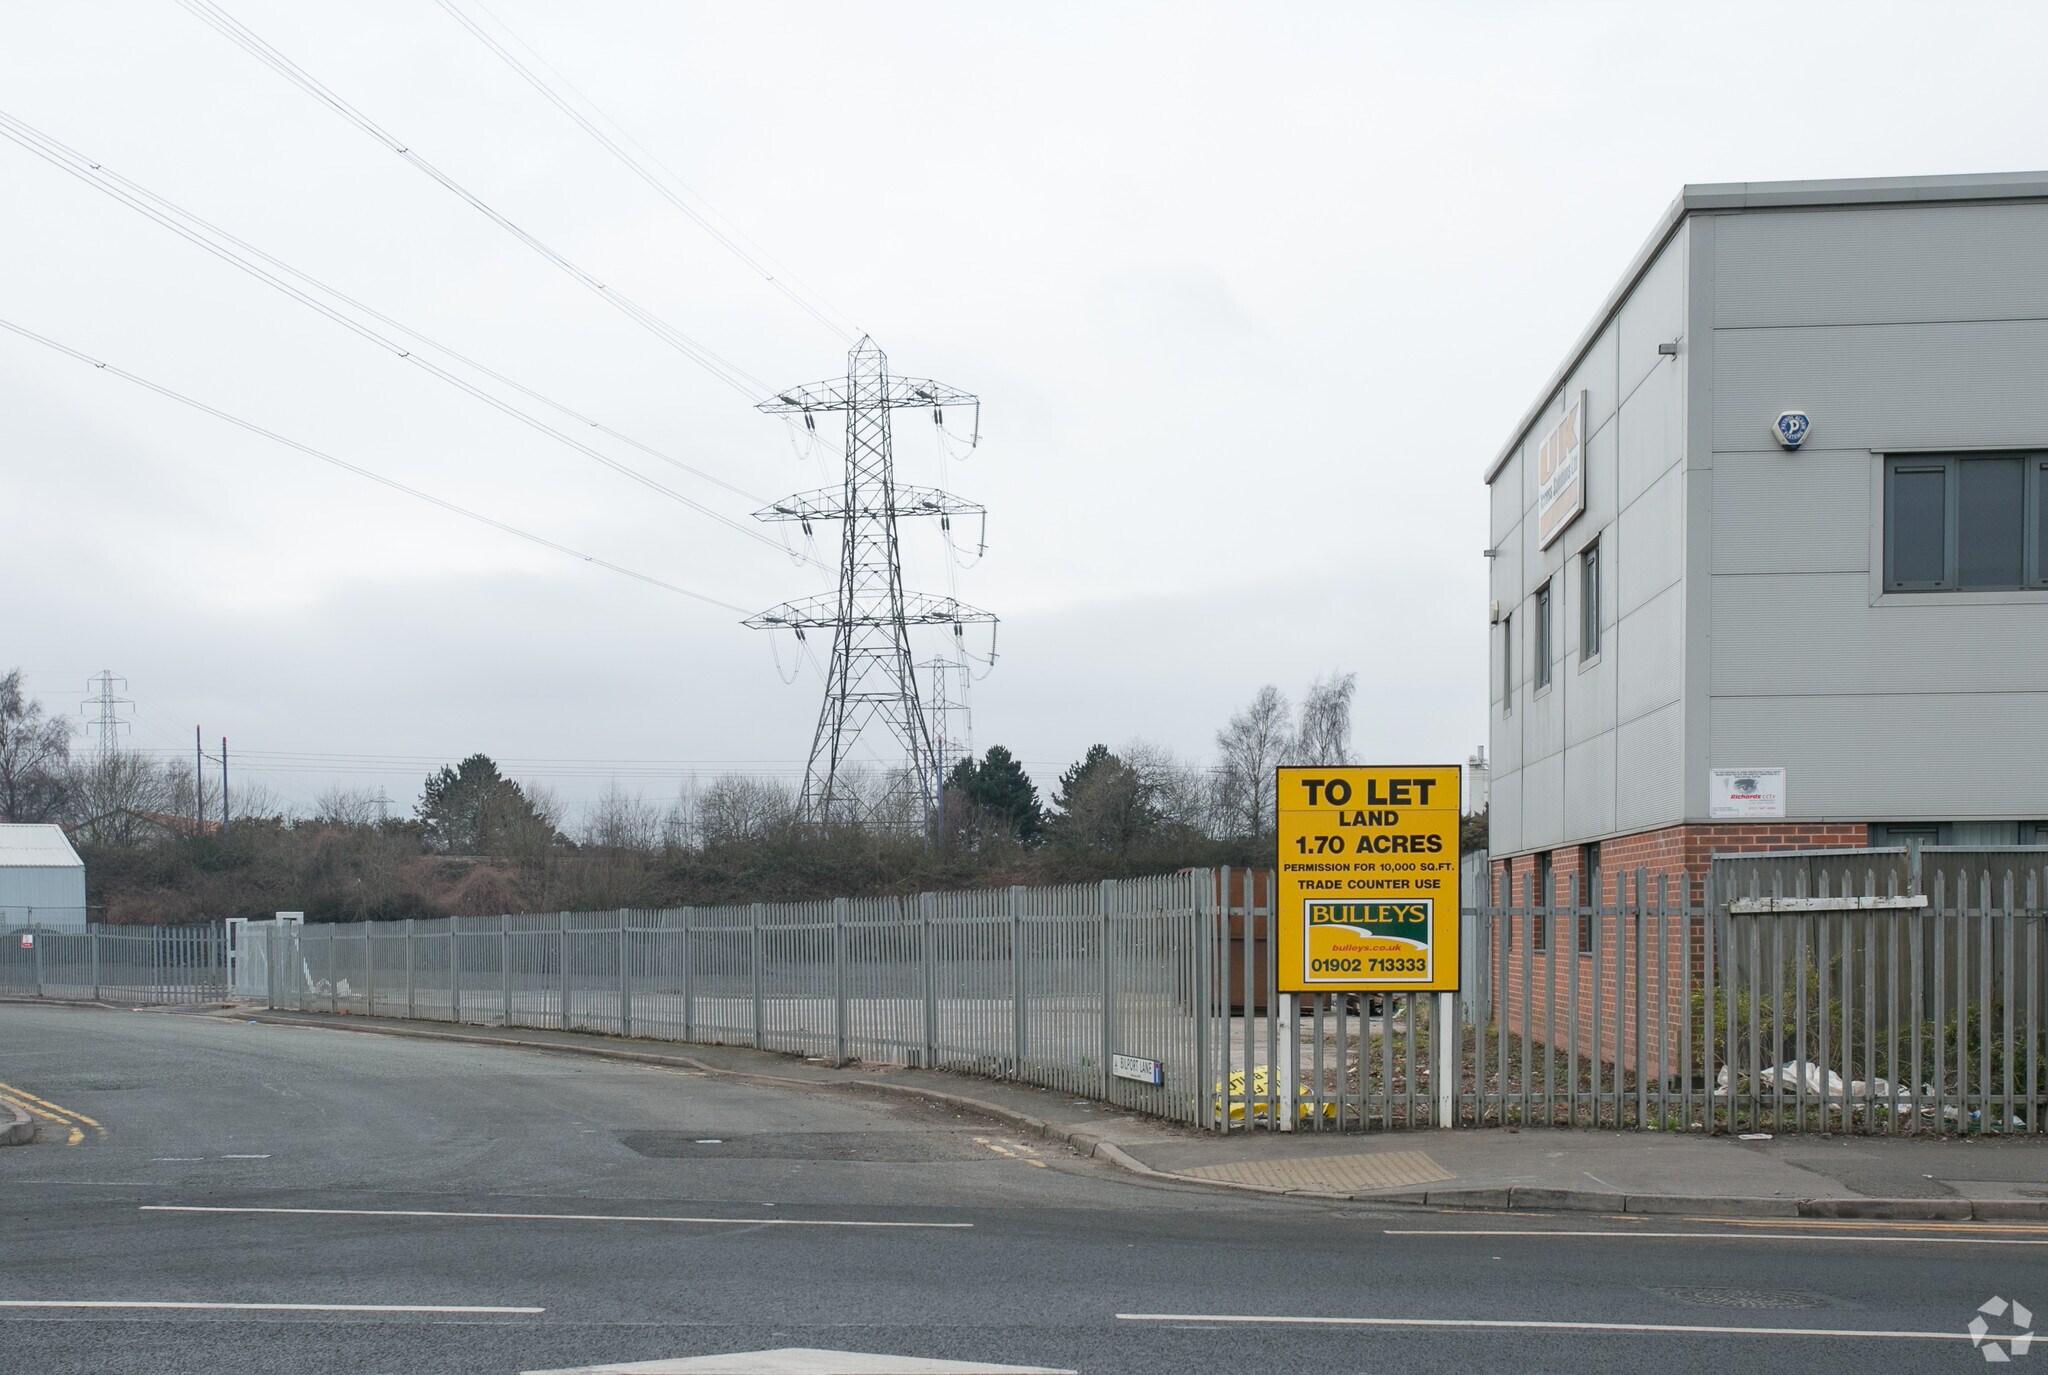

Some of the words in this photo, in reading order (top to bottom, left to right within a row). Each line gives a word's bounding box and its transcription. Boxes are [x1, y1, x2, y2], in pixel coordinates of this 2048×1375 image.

[1540, 401, 1579, 486] UK
[1301, 778, 1352, 806] TO
[1367, 778, 1437, 806] LET
[1338, 810, 1399, 827] LAND
[1295, 835, 1345, 854] 1.70
[1355, 834, 1443, 854] ACRES
[1283, 863, 1350, 873] PERMISSION
[1353, 863, 1376, 872] FOR
[1379, 863, 1416, 873] 10,000
[1419, 862, 1455, 872] SQ.FT.
[1297, 880, 1343, 890] TRADE
[1347, 879, 1410, 890] COUNTER
[1414, 879, 1441, 889] USE
[1312, 905, 1426, 924] BULLEYS
[1331, 943, 1401, 953] bulleys.co.uk
[1311, 958, 1362, 972] 01902
[1368, 958, 1426, 972] 713333
[1120, 1056, 1139, 1071] BILPORT
[1140, 1060, 1152, 1075] LANE
